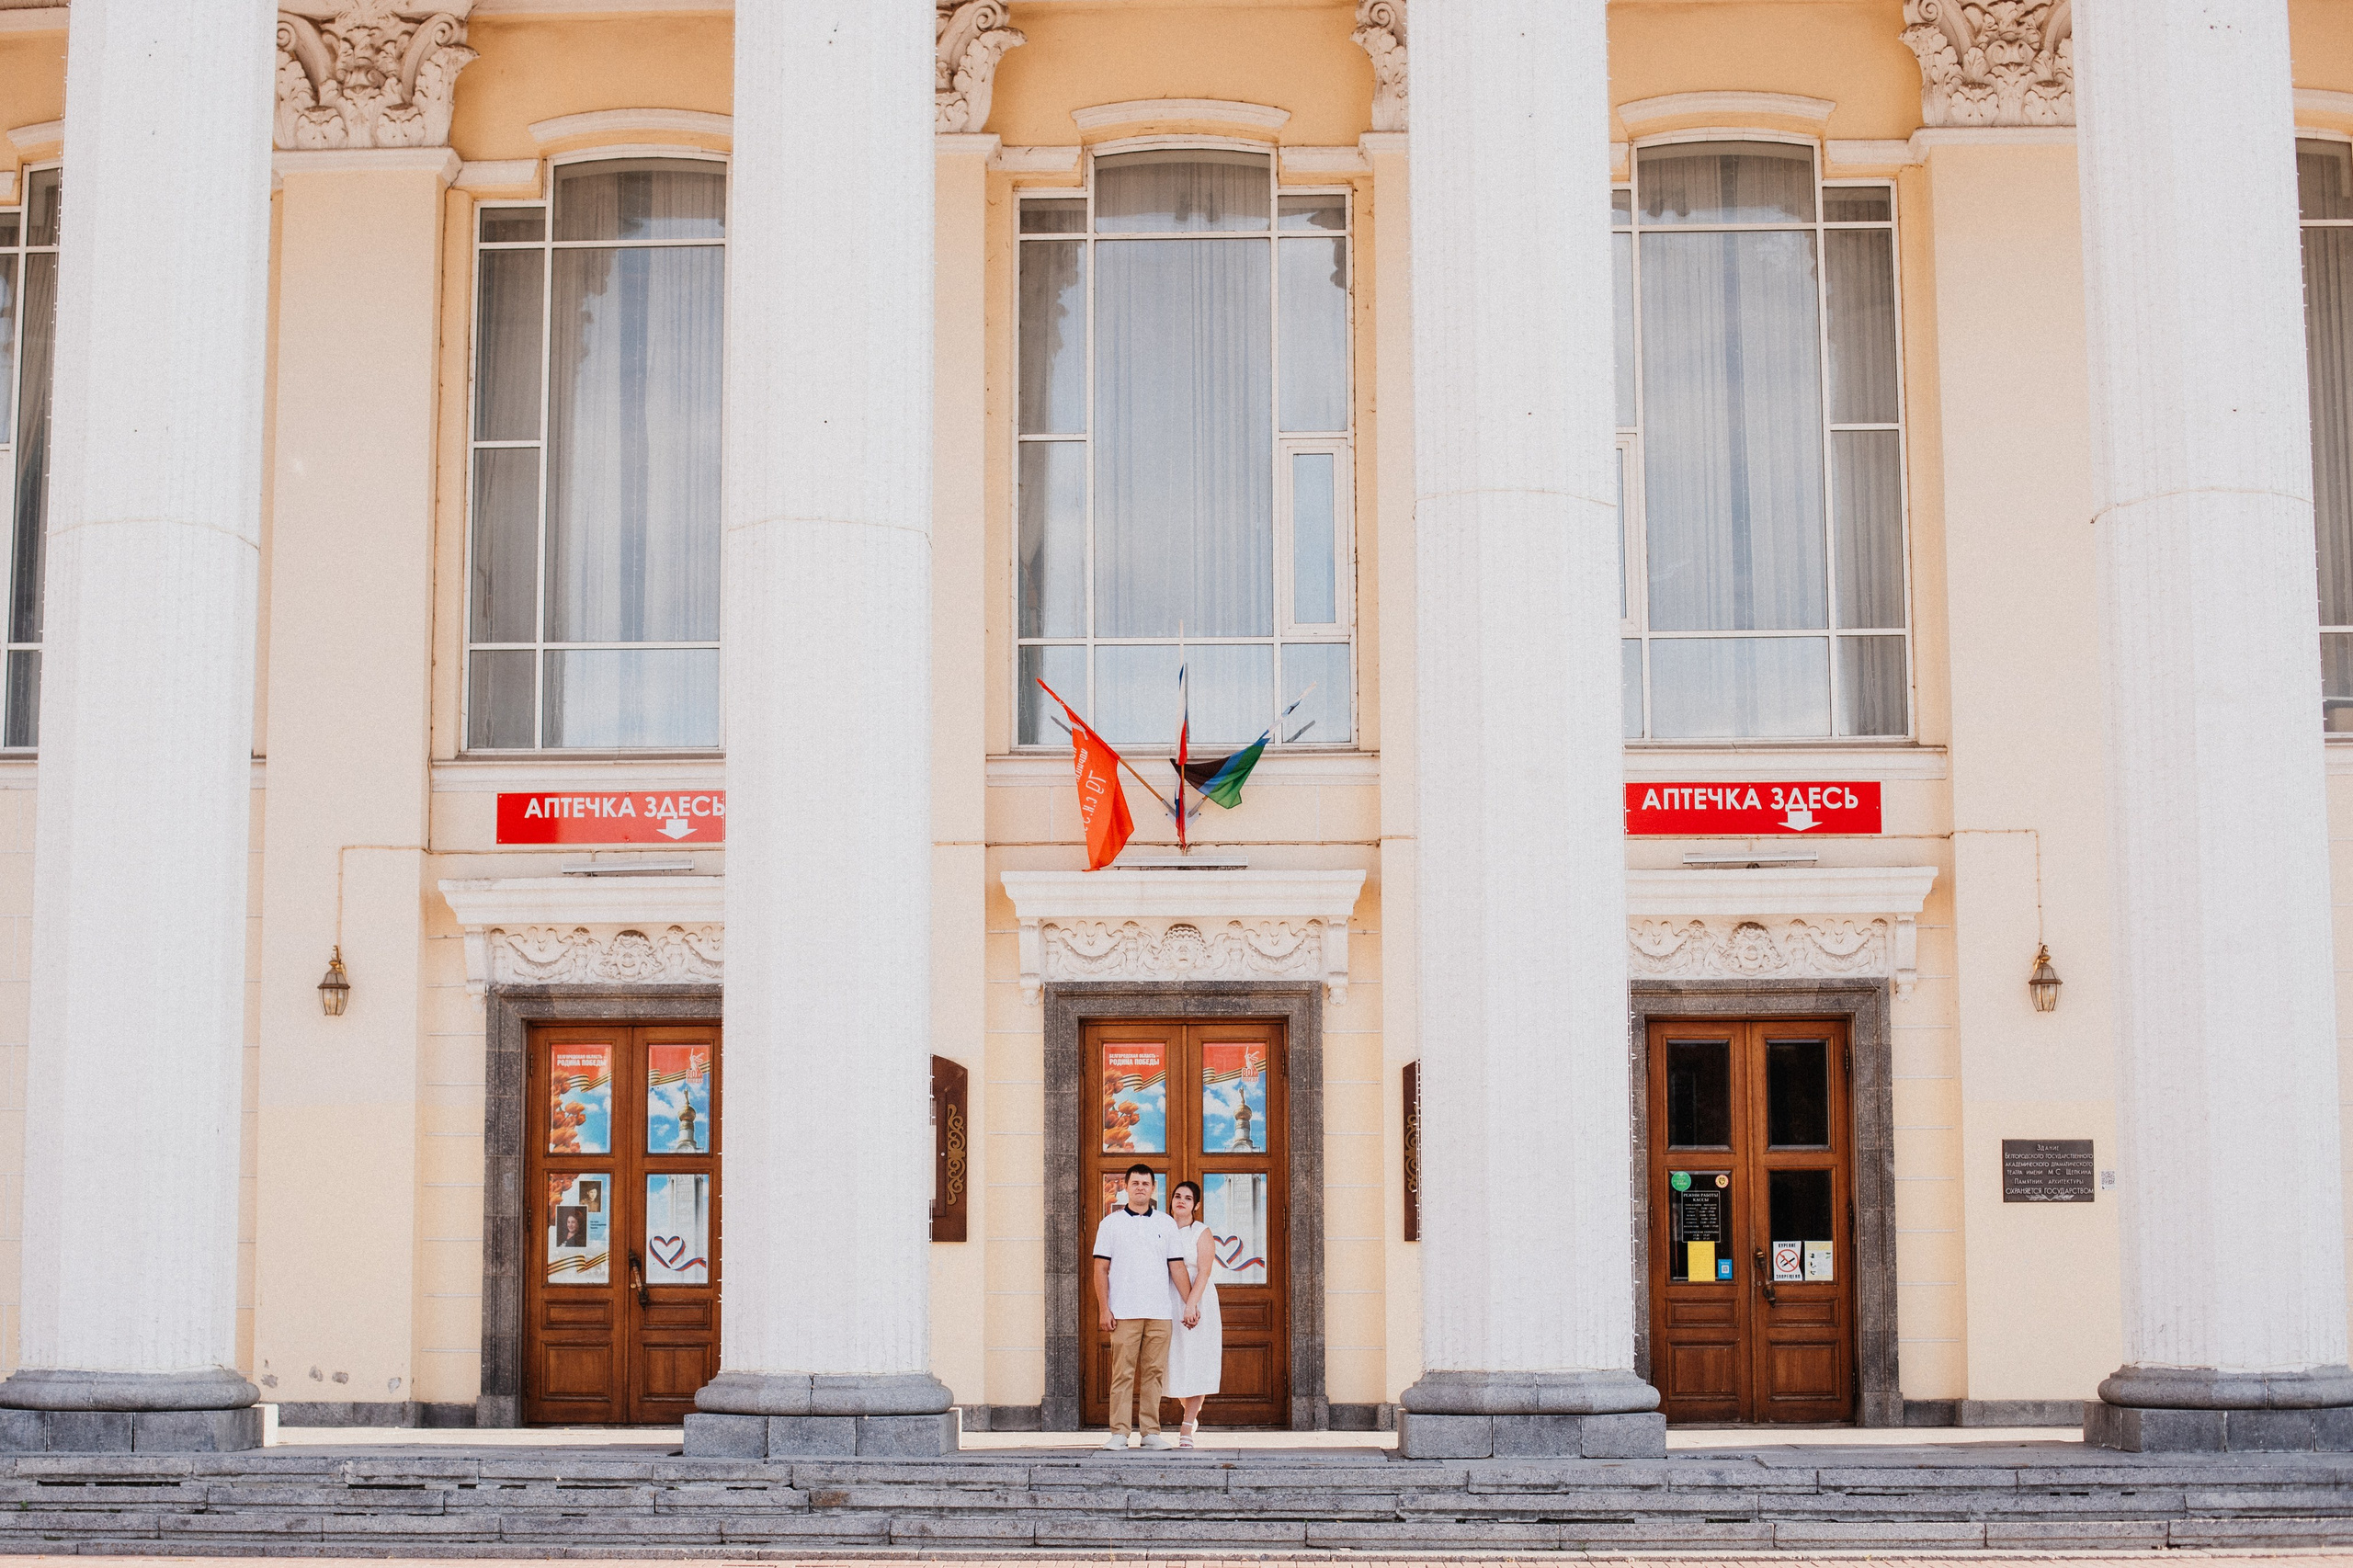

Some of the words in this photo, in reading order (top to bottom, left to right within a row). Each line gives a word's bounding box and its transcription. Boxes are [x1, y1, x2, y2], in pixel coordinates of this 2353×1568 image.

[524, 797, 637, 819] АПТЕЧКА
[643, 795, 726, 820] ЗДЕСЬ
[1642, 788, 1762, 811] АПТЕЧКА
[1770, 786, 1859, 812] ЗДЕСЬ
[1108, 1058, 1133, 1066] РОДИНА
[1134, 1058, 1160, 1066] ПОБЕДЫ
